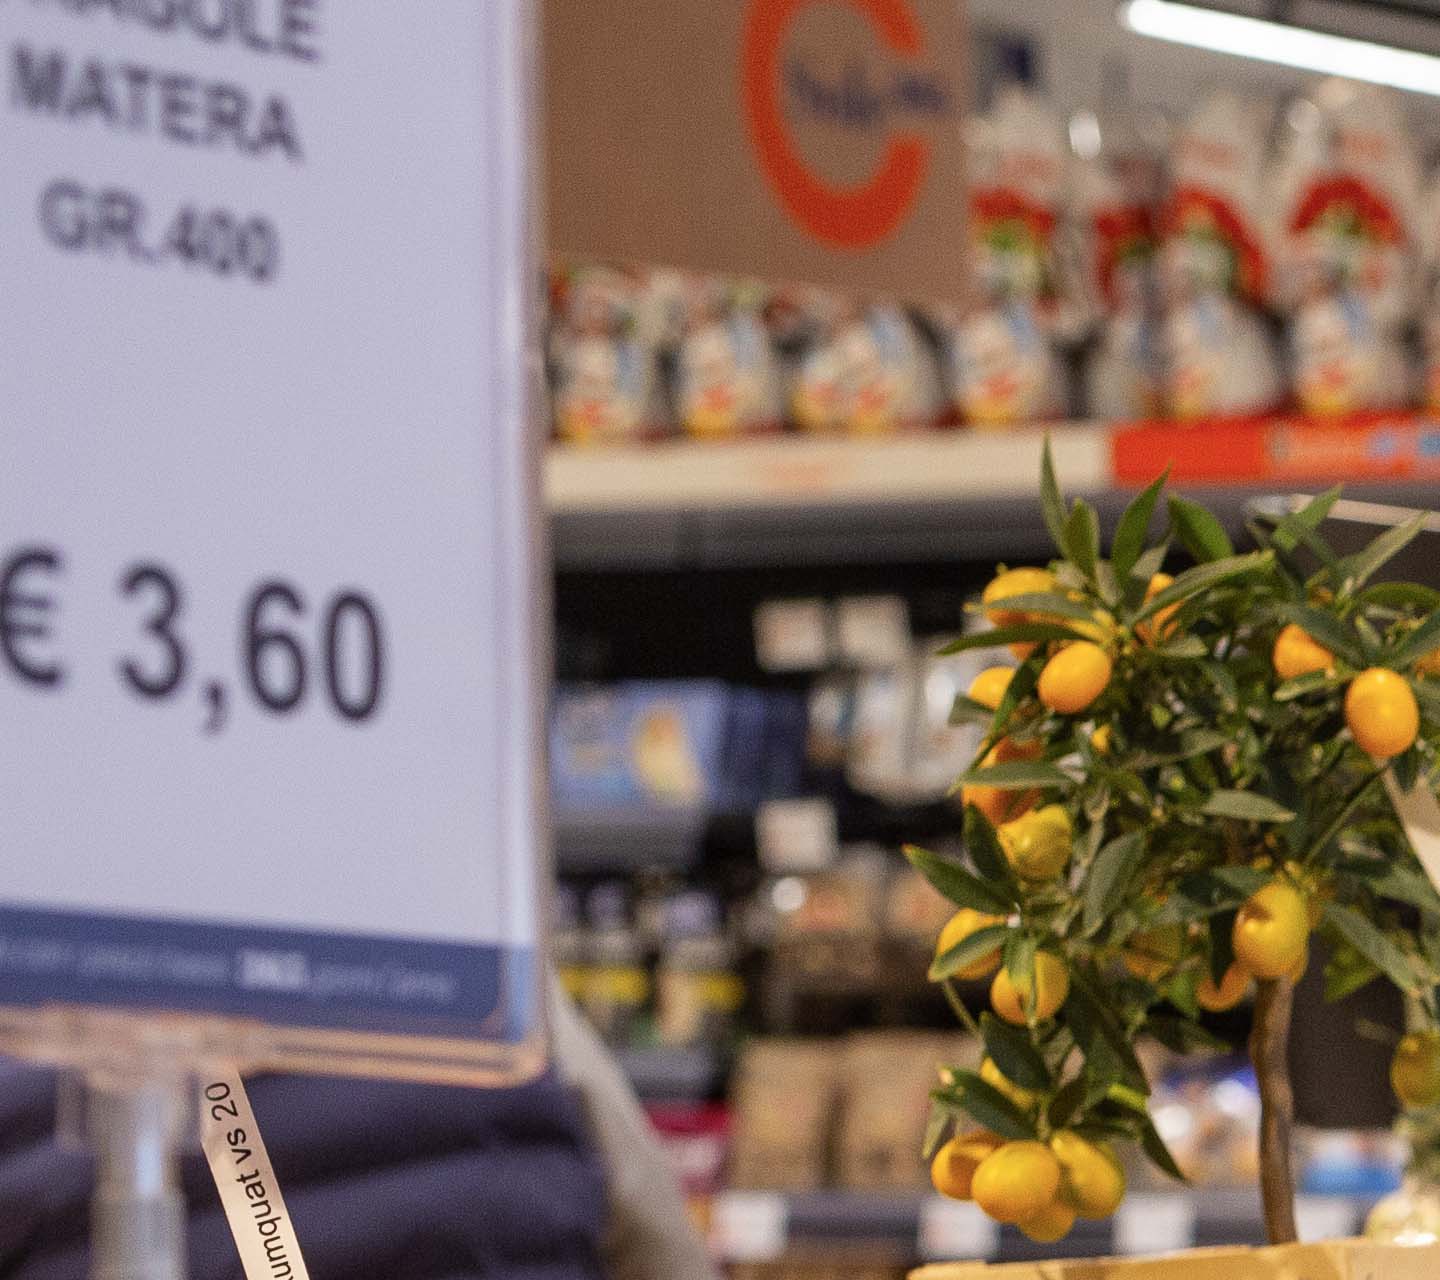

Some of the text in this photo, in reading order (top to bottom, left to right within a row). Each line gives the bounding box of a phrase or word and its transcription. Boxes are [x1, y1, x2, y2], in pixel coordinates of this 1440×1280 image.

[10, 43, 304, 161] MATERA
[38, 180, 282, 283] GR.400
[118, 563, 386, 735] 3,60
[205, 1082, 239, 1122] 20
[227, 1127, 252, 1165] vs
